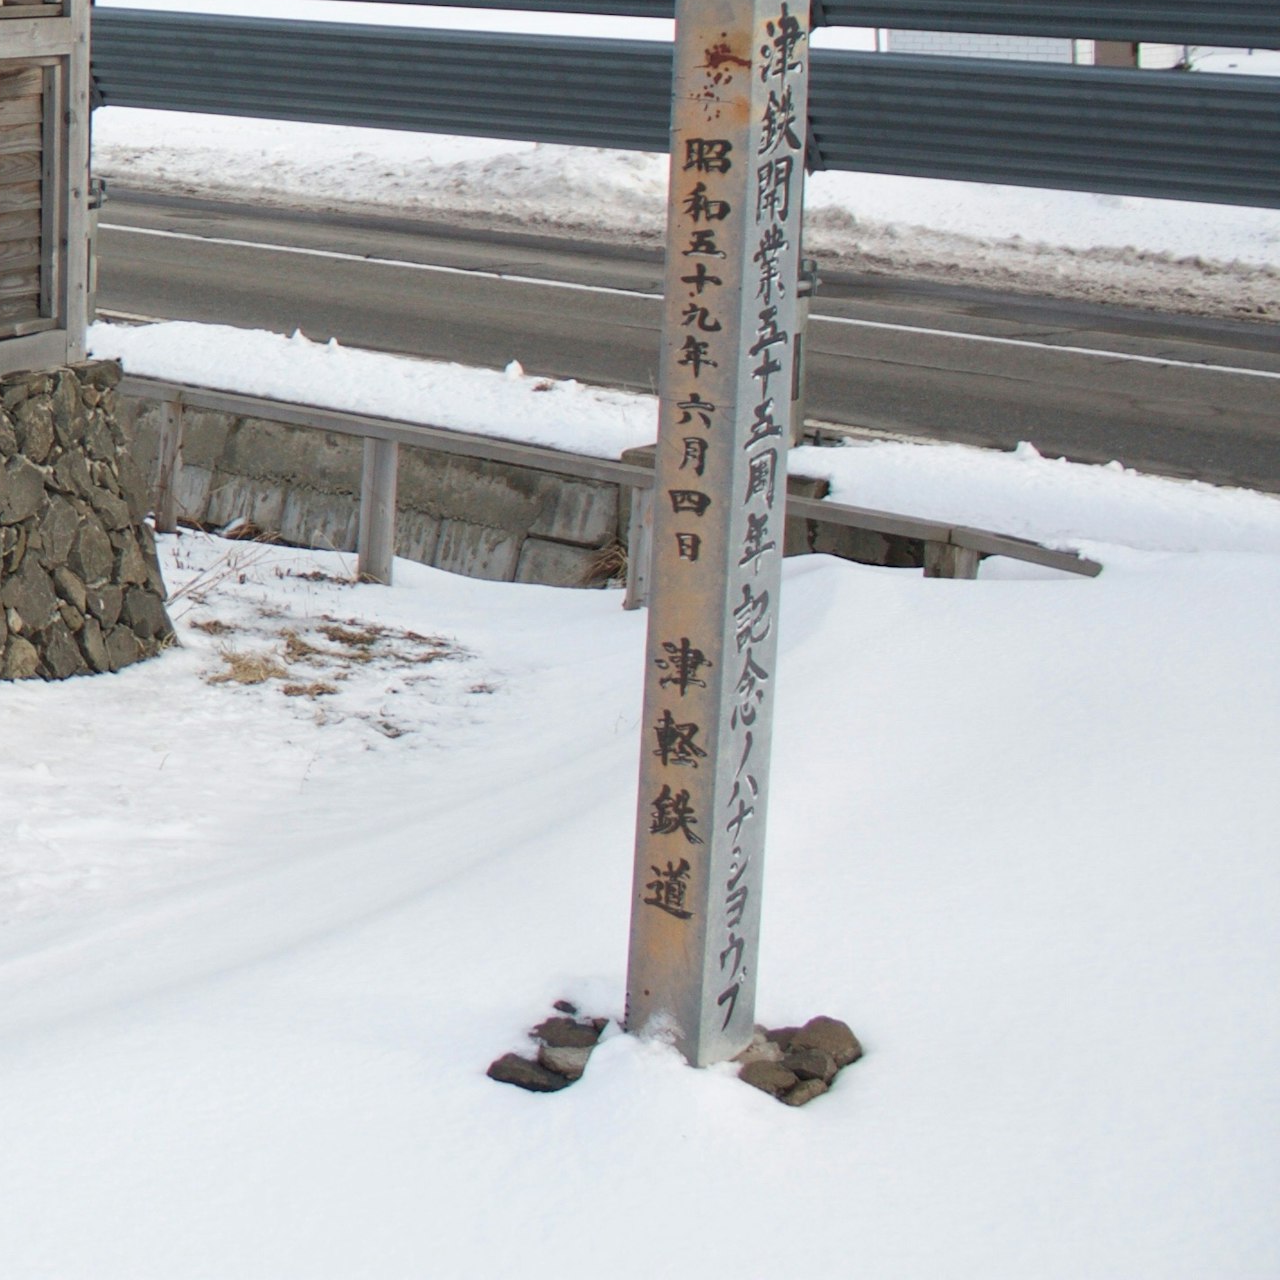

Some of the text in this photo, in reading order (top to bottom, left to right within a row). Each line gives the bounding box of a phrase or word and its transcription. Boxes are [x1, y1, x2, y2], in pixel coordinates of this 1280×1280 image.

[668, 137, 733, 563] 昭和五十九年六月四日
[643, 636, 713, 921] 津軽鉄道
